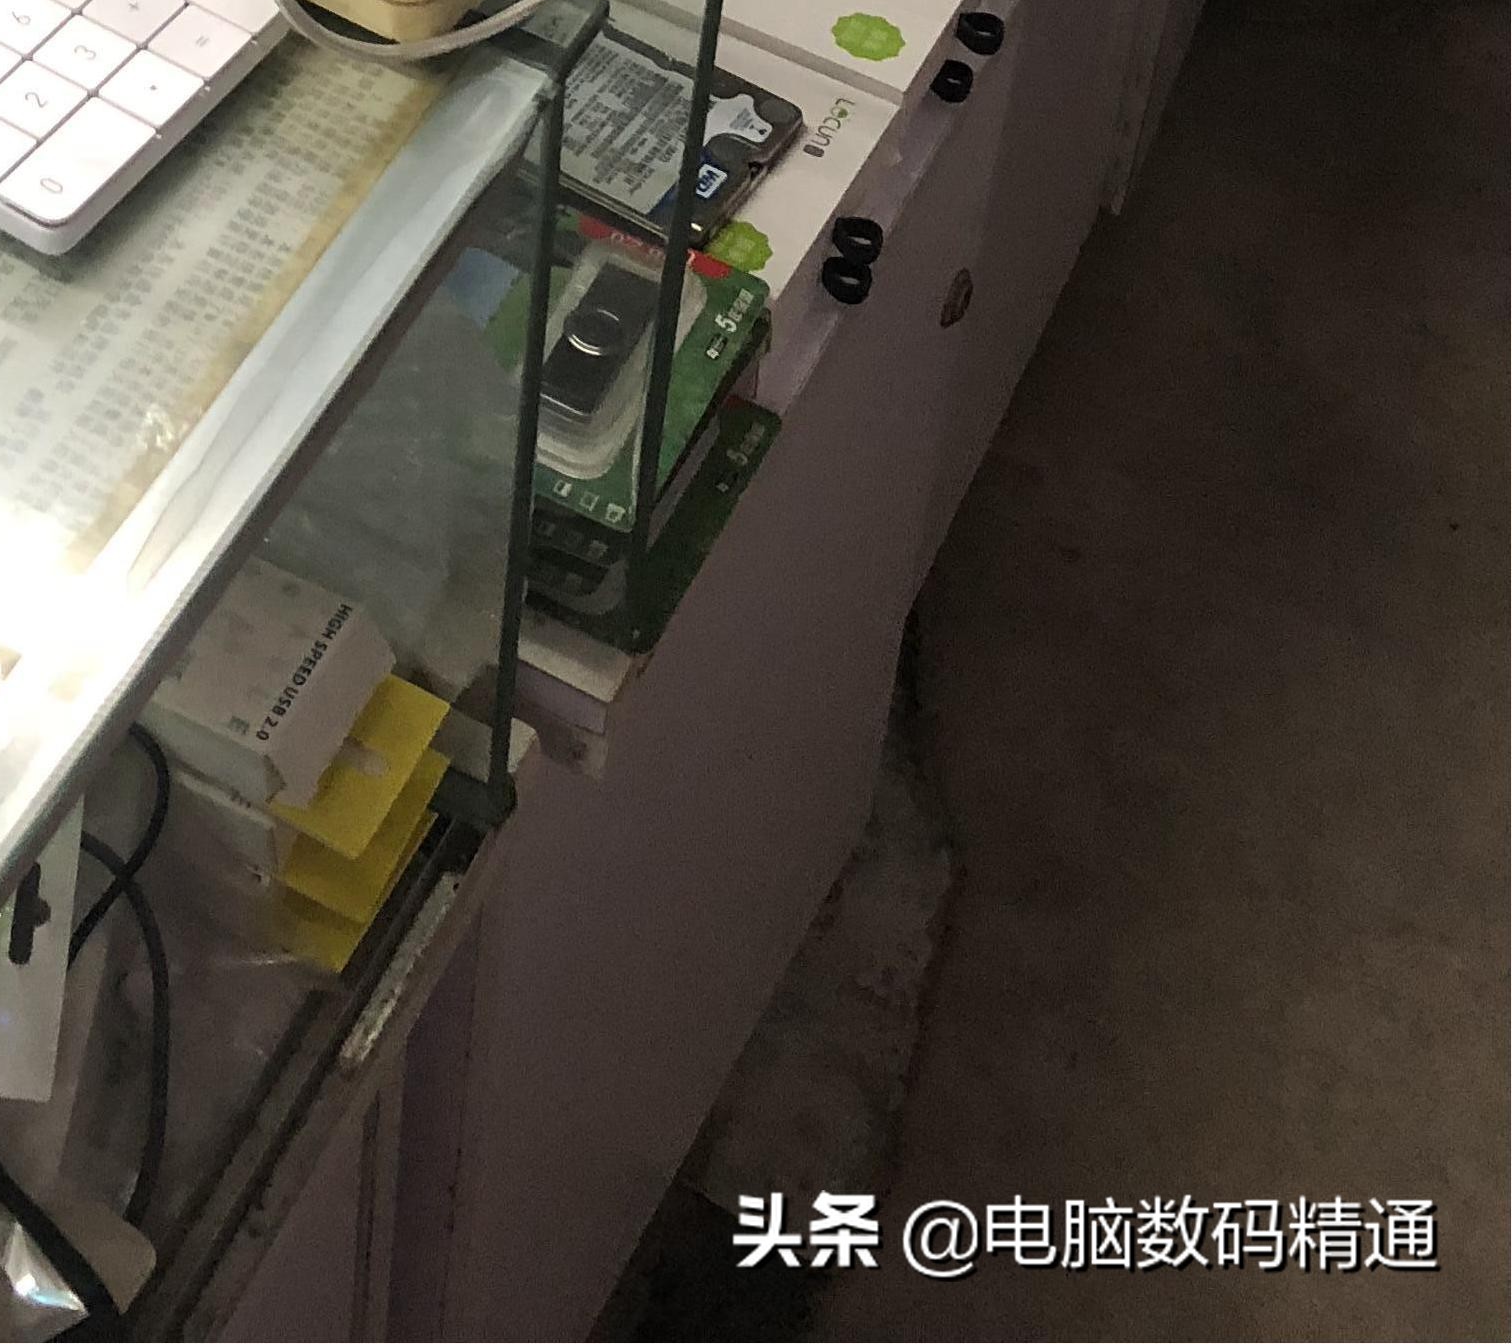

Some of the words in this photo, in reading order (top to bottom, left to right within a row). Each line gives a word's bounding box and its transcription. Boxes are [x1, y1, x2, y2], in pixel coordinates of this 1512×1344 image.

[322, 603, 352, 639] HIGH
[291, 639, 328, 686] SPEED
[271, 686, 299, 717] USB
[256, 716, 279, 741] 2.0
